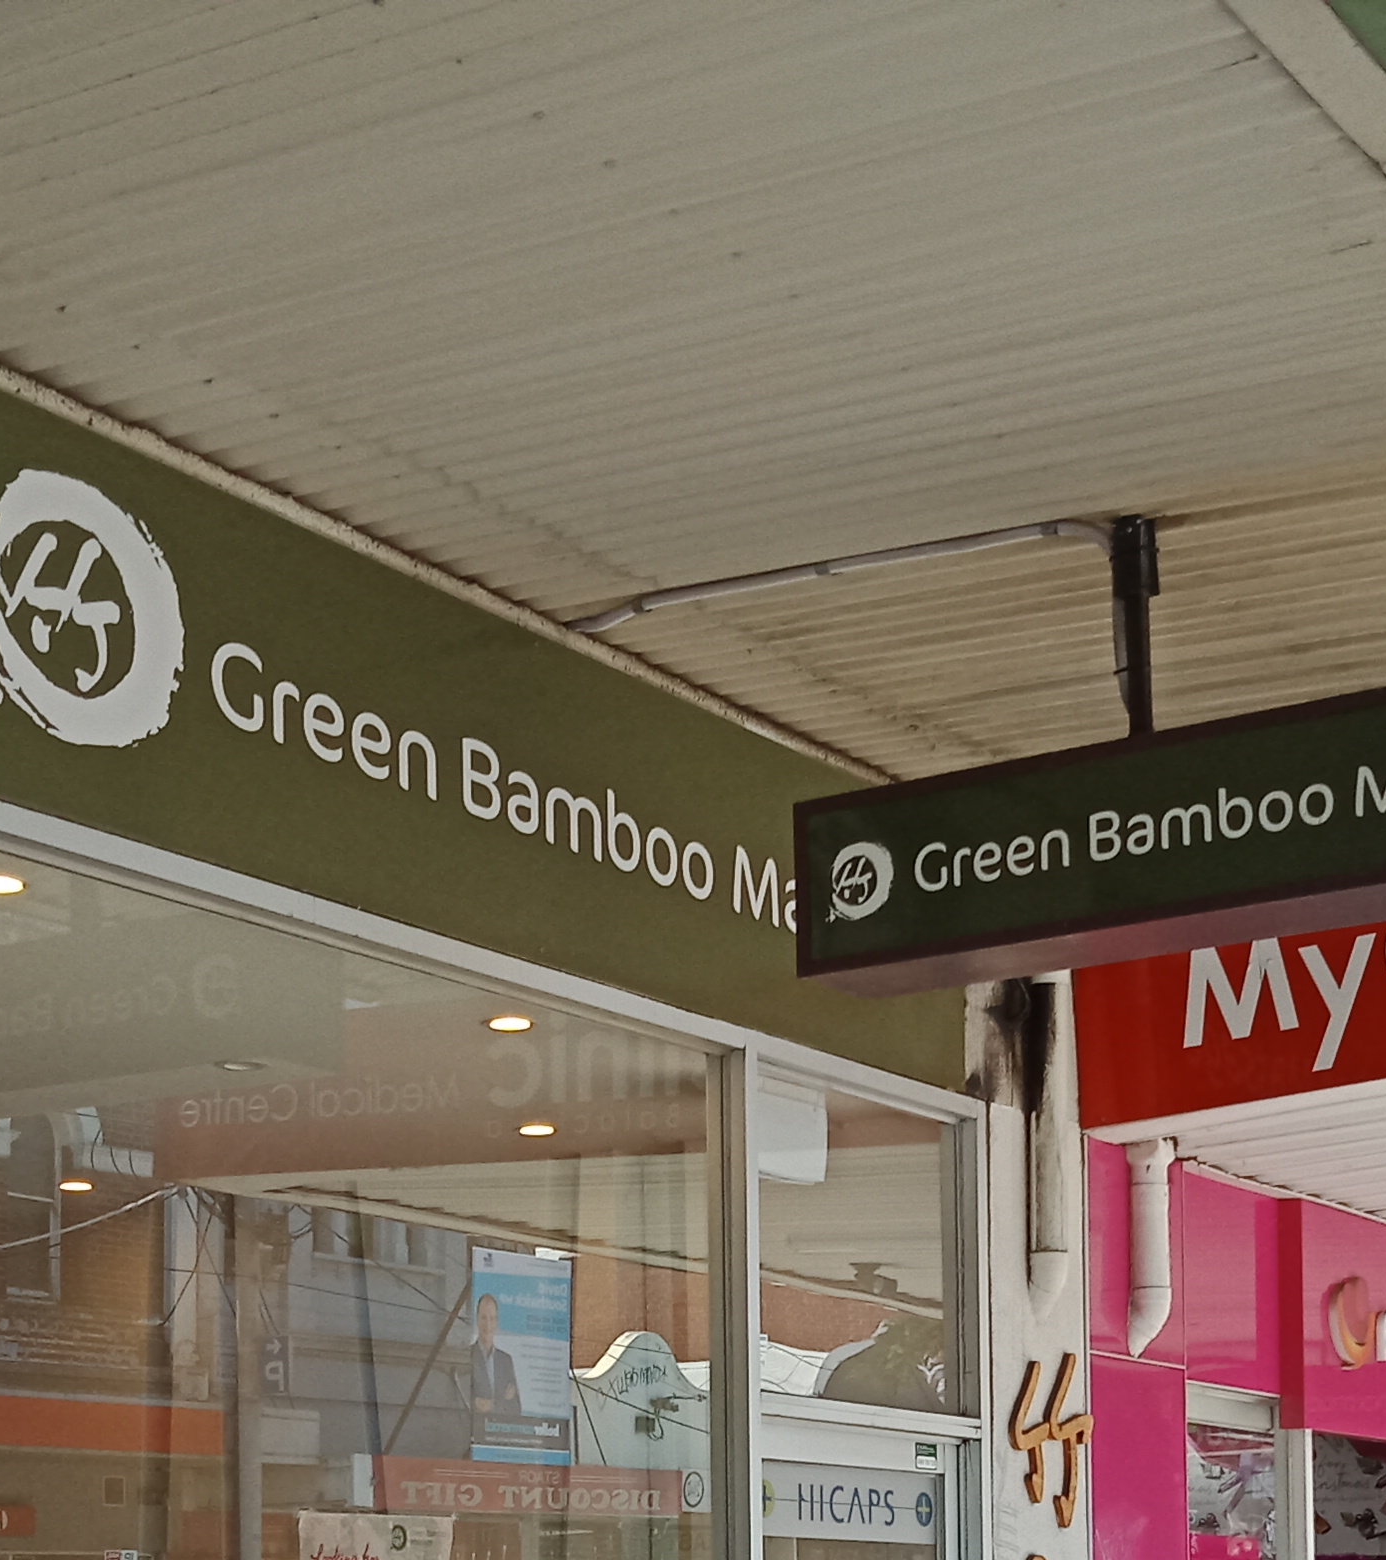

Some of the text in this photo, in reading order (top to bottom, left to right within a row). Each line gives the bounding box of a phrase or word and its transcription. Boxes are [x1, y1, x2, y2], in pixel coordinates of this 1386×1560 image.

[212, 641, 438, 801] Green
[461, 737, 715, 901] Bamboo
[912, 825, 1070, 894] Green
[1089, 779, 1335, 863] Bamboo
[796, 1483, 896, 1527] HICAPS
